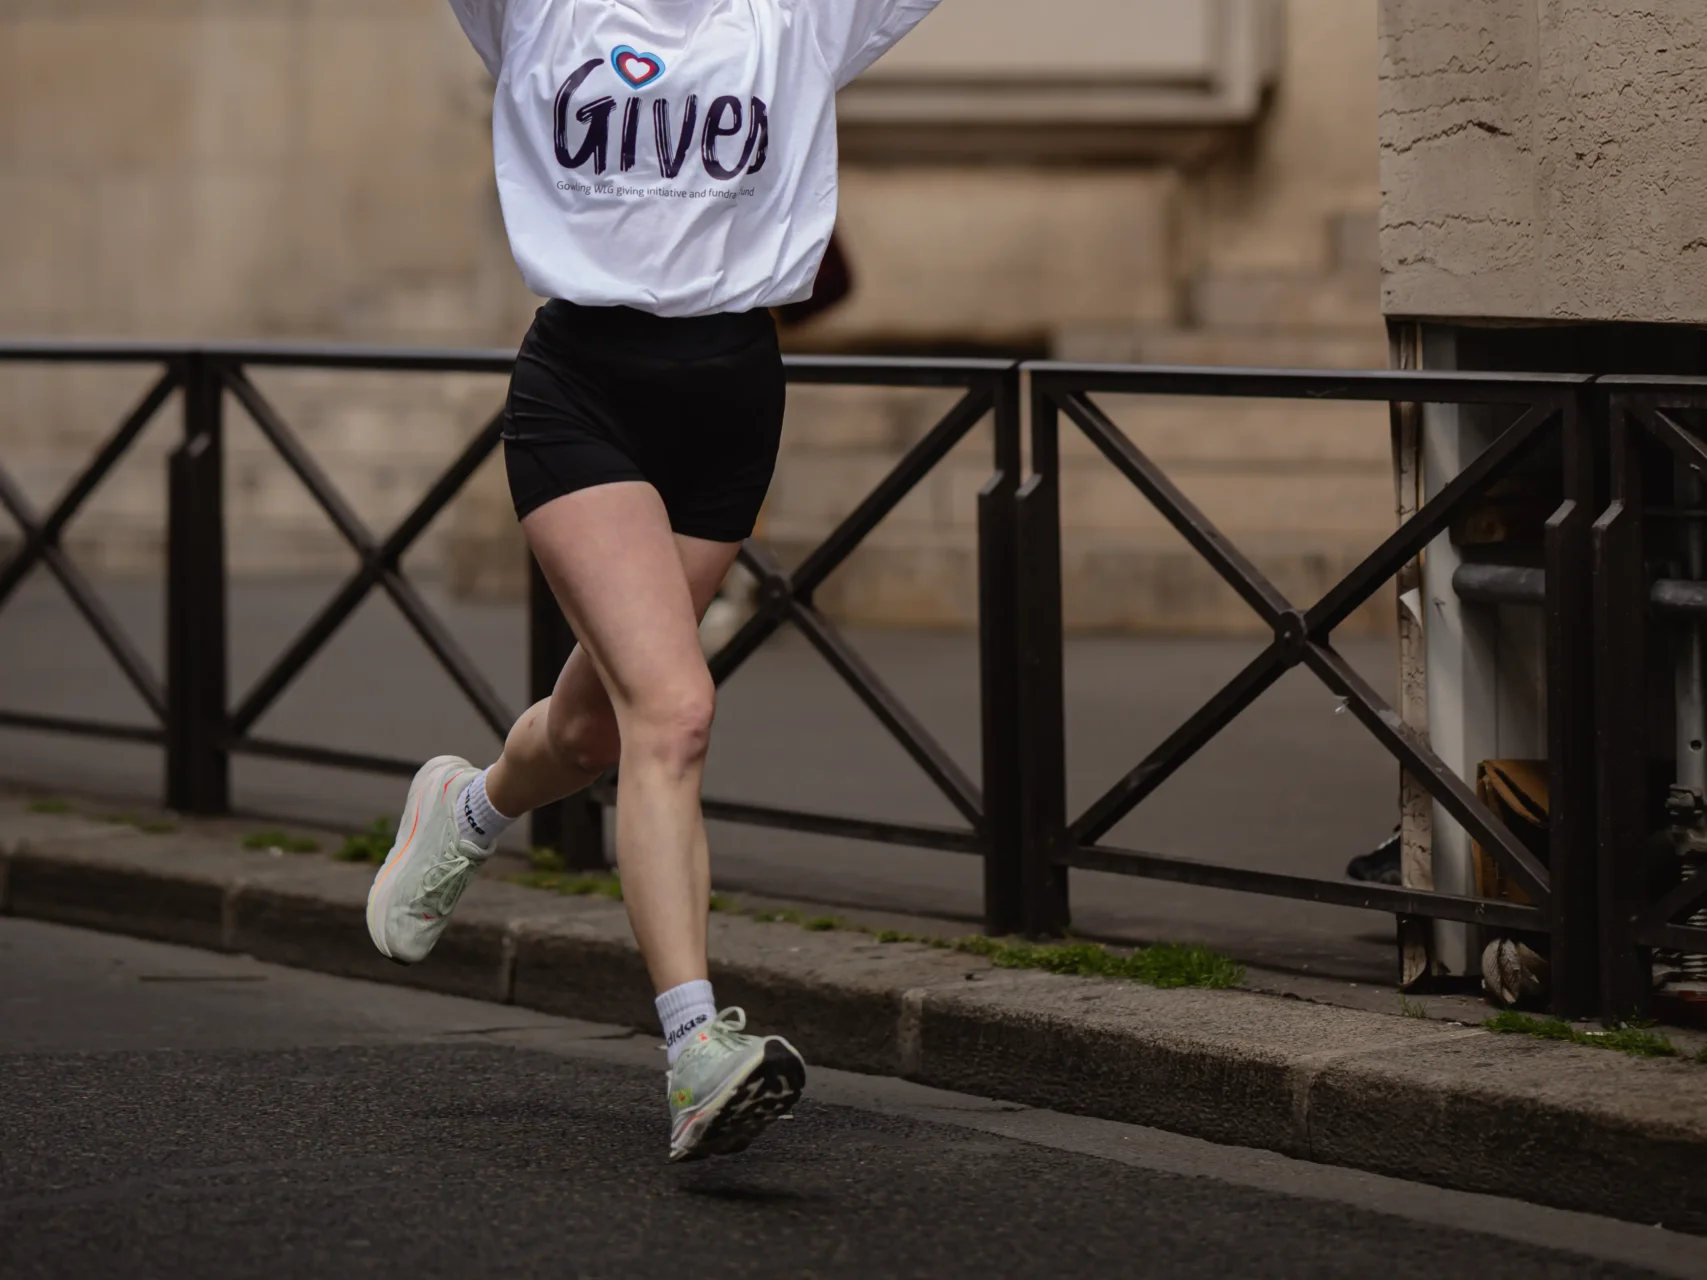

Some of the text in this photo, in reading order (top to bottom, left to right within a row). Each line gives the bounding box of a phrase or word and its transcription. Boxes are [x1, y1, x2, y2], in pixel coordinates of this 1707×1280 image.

[556, 180, 591, 196] Gowling
[594, 184, 614, 194] WLG
[616, 186, 644, 197] giving
[647, 186, 687, 197] initiative
[689, 189, 706, 199] and
[708, 188, 737, 199] fundra
[667, 1014, 707, 1047] didas
